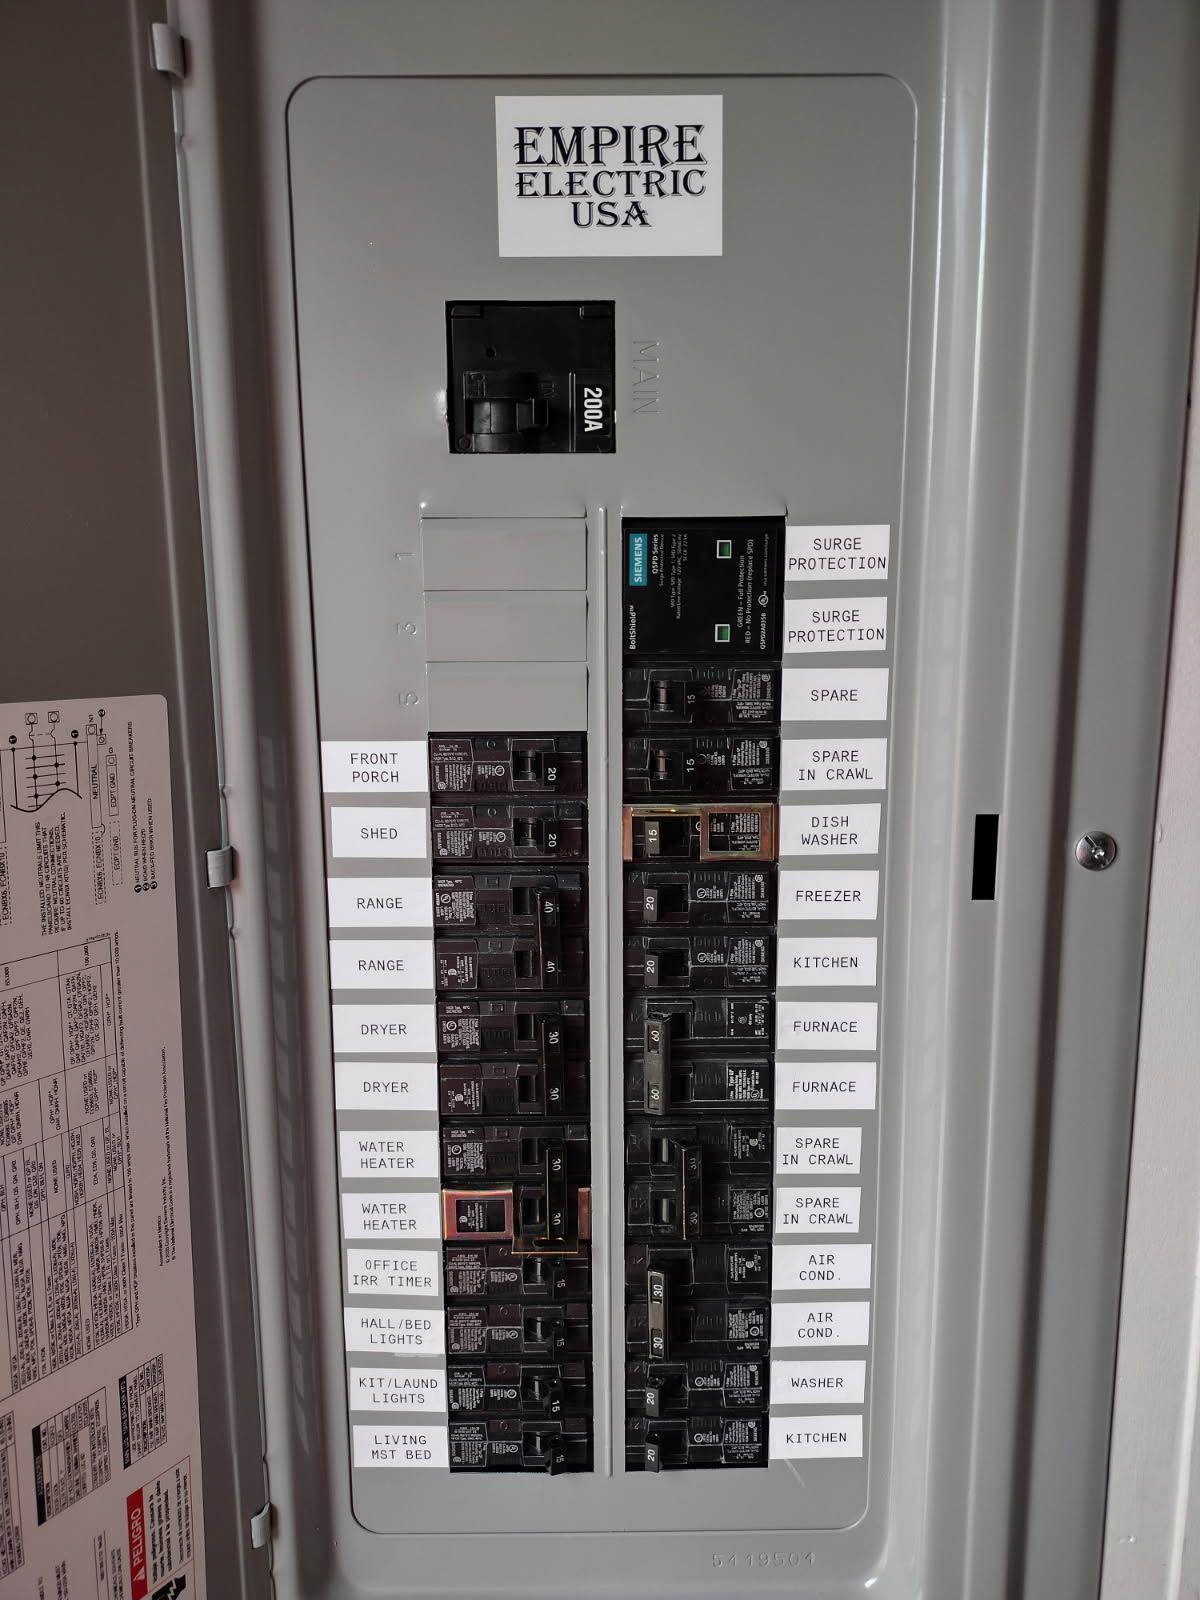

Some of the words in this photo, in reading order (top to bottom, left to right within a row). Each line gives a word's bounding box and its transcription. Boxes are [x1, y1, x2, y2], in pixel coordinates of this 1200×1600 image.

[514, 125, 707, 169] EMPIRE
[516, 169, 706, 198] ELECTRIC
[571, 201, 652, 228] USA
[633, 340, 660, 413] MAIN
[584, 387, 603, 432] 200A
[814, 538, 861, 550] SURGE
[634, 537, 643, 582] SIEMENS
[789, 557, 885, 570] PROTECTION
[745, 615, 751, 623] No
[813, 610, 859, 623] SURGE
[396, 623, 416, 635] 3
[789, 629, 884, 642] PROTECTION
[688, 694, 695, 704] 15
[811, 690, 857, 701] SPARE
[351, 753, 397, 764] FRONT
[813, 751, 858, 762] SPARE
[686, 759, 695, 772] 15
[353, 771, 398, 782] PORCH
[547, 768, 556, 781] 20
[799, 769, 815, 780] IN
[827, 768, 872, 780] CRAWL
[90, 764, 98, 799] NEUTRAL
[812, 816, 848, 827] DISH
[361, 828, 397, 839] SHED
[649, 829, 657, 843] 15
[549, 833, 556, 847] 20
[802, 834, 857, 845] WASHER
[94, 836, 102, 868] ECNBX10
[797, 891, 860, 901] FREEZER
[357, 898, 403, 909] RANGE
[543, 901, 554, 913] 40
[646, 896, 654, 910] 20
[359, 960, 404, 970] RANGE
[546, 960, 555, 973] 40
[647, 960, 655, 973] 20
[794, 957, 857, 968] KITCHEN
[362, 1024, 406, 1034] DRYER
[794, 1021, 857, 1032] FURNACE
[549, 1032, 559, 1044] 30
[651, 1030, 659, 1042] 60
[364, 1082, 408, 1092] DRYER
[793, 1082, 855, 1092] FURNACE
[549, 1088, 559, 1101] 30
[651, 1089, 660, 1100] 60
[359, 1142, 404, 1152] WATER
[796, 1138, 839, 1148] SPARE
[361, 1158, 414, 1168] HEATER
[552, 1159, 561, 1171] 30
[783, 1154, 798, 1165] IN
[809, 1154, 853, 1164] CRAWL
[796, 1198, 839, 1208] SPARE
[362, 1204, 406, 1214] WATER
[552, 1213, 560, 1225] 30
[784, 1214, 798, 1224] IN
[810, 1214, 852, 1224] CRAWL
[364, 1220, 416, 1230] HEATER
[365, 1260, 417, 1271] OFFICE
[809, 1255, 834, 1265] AIR
[354, 1275, 377, 1285] IRR
[388, 1276, 431, 1287] TIMER
[799, 1270, 841, 1281] COND.
[557, 1279, 566, 1288] 15
[654, 1285, 663, 1297] 30
[808, 1313, 832, 1322] AIR
[362, 1318, 431, 1329] HALL/BED
[798, 1328, 840, 1338] COND.
[371, 1334, 422, 1344] LIGHTS
[557, 1339, 564, 1347] 15
[654, 1337, 663, 1349] 30
[360, 1378, 437, 1388] KIT/LAUND
[792, 1378, 843, 1387] WASHER
[373, 1394, 424, 1403] LIGHTS
[647, 1393, 655, 1405] 20
[552, 1400, 560, 1413] 15
[375, 1435, 426, 1444] LIVING
[787, 1433, 846, 1443] KITCHEN
[372, 1450, 396, 1459] MST
[406, 1450, 431, 1459] BED
[557, 1454, 563, 1463] 15
[647, 1450, 655, 1461] 20
[131, 1508, 144, 1566] PELIGRO
